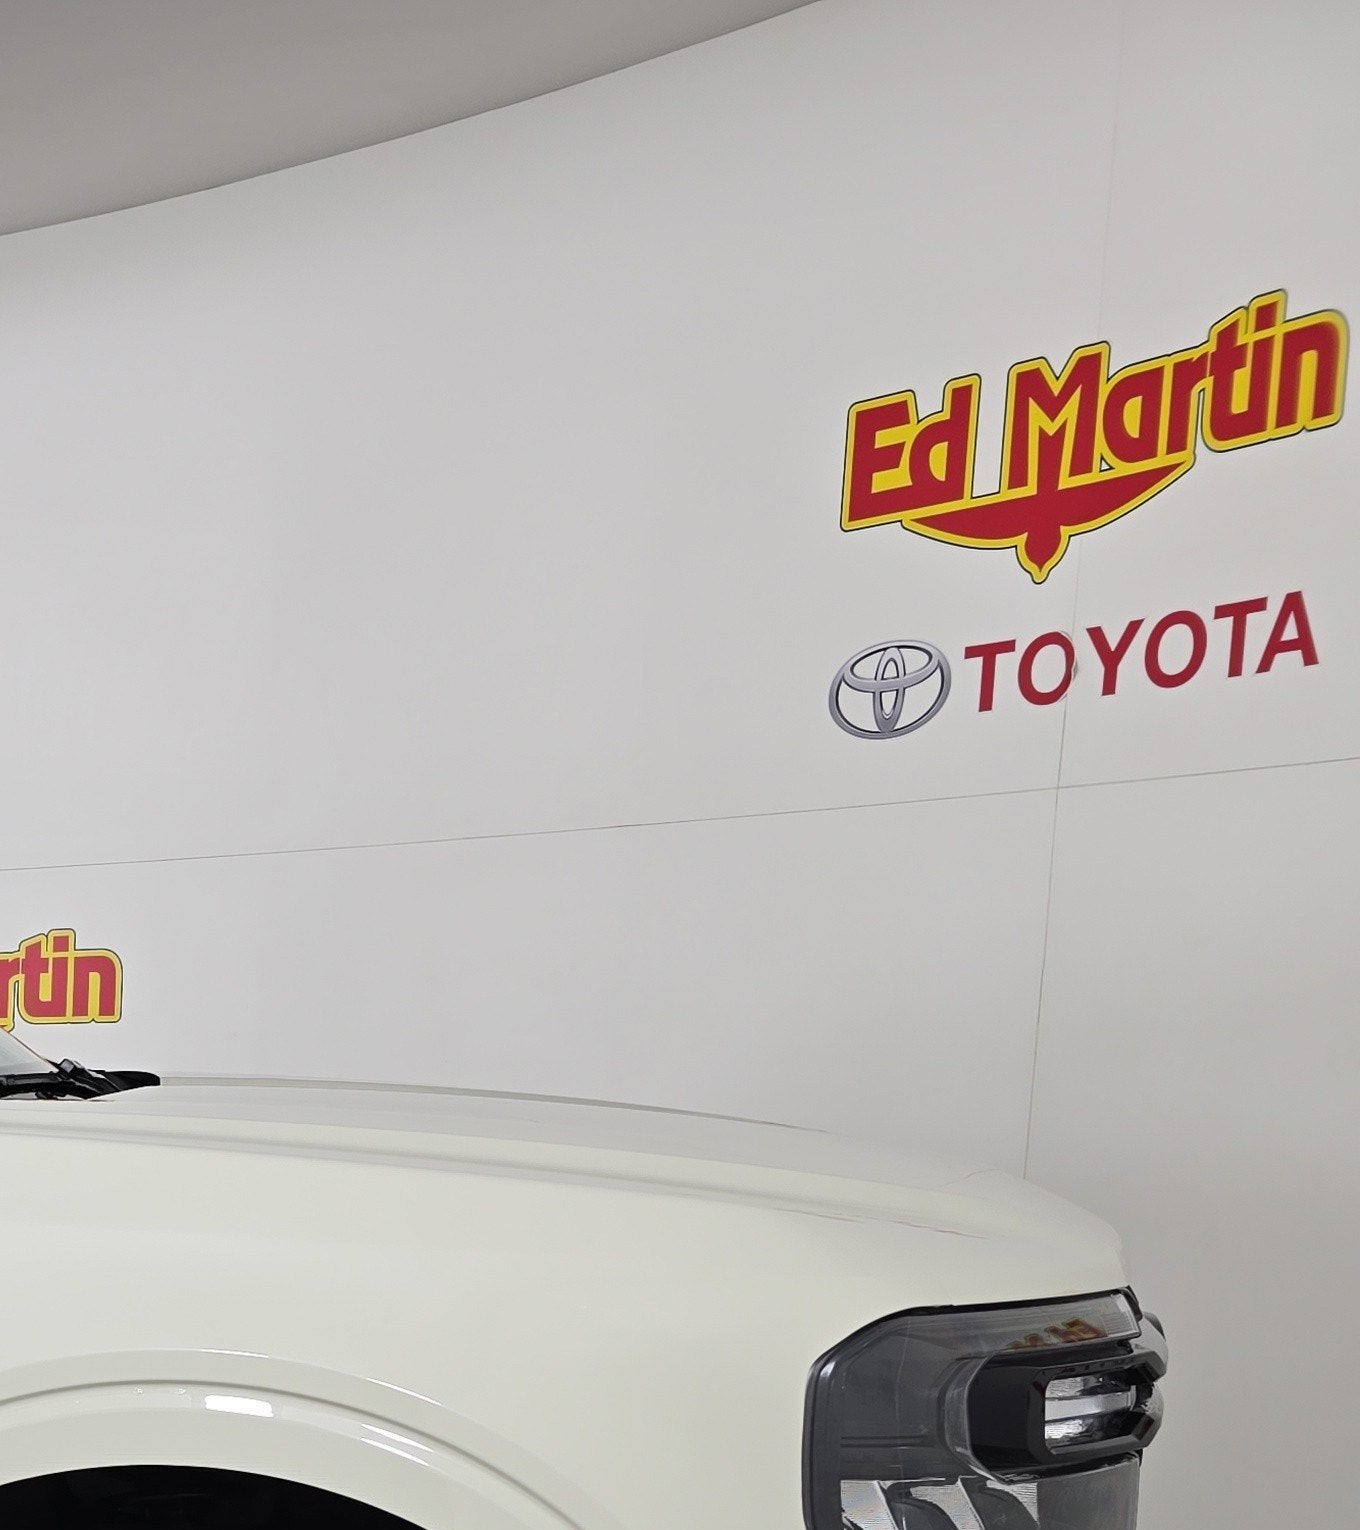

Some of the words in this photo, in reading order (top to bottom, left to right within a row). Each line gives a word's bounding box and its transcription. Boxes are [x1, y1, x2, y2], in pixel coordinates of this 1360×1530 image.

[845, 384, 974, 522] Ed
[1006, 298, 1338, 492] Martin
[963, 590, 1319, 713] TOYOTA
